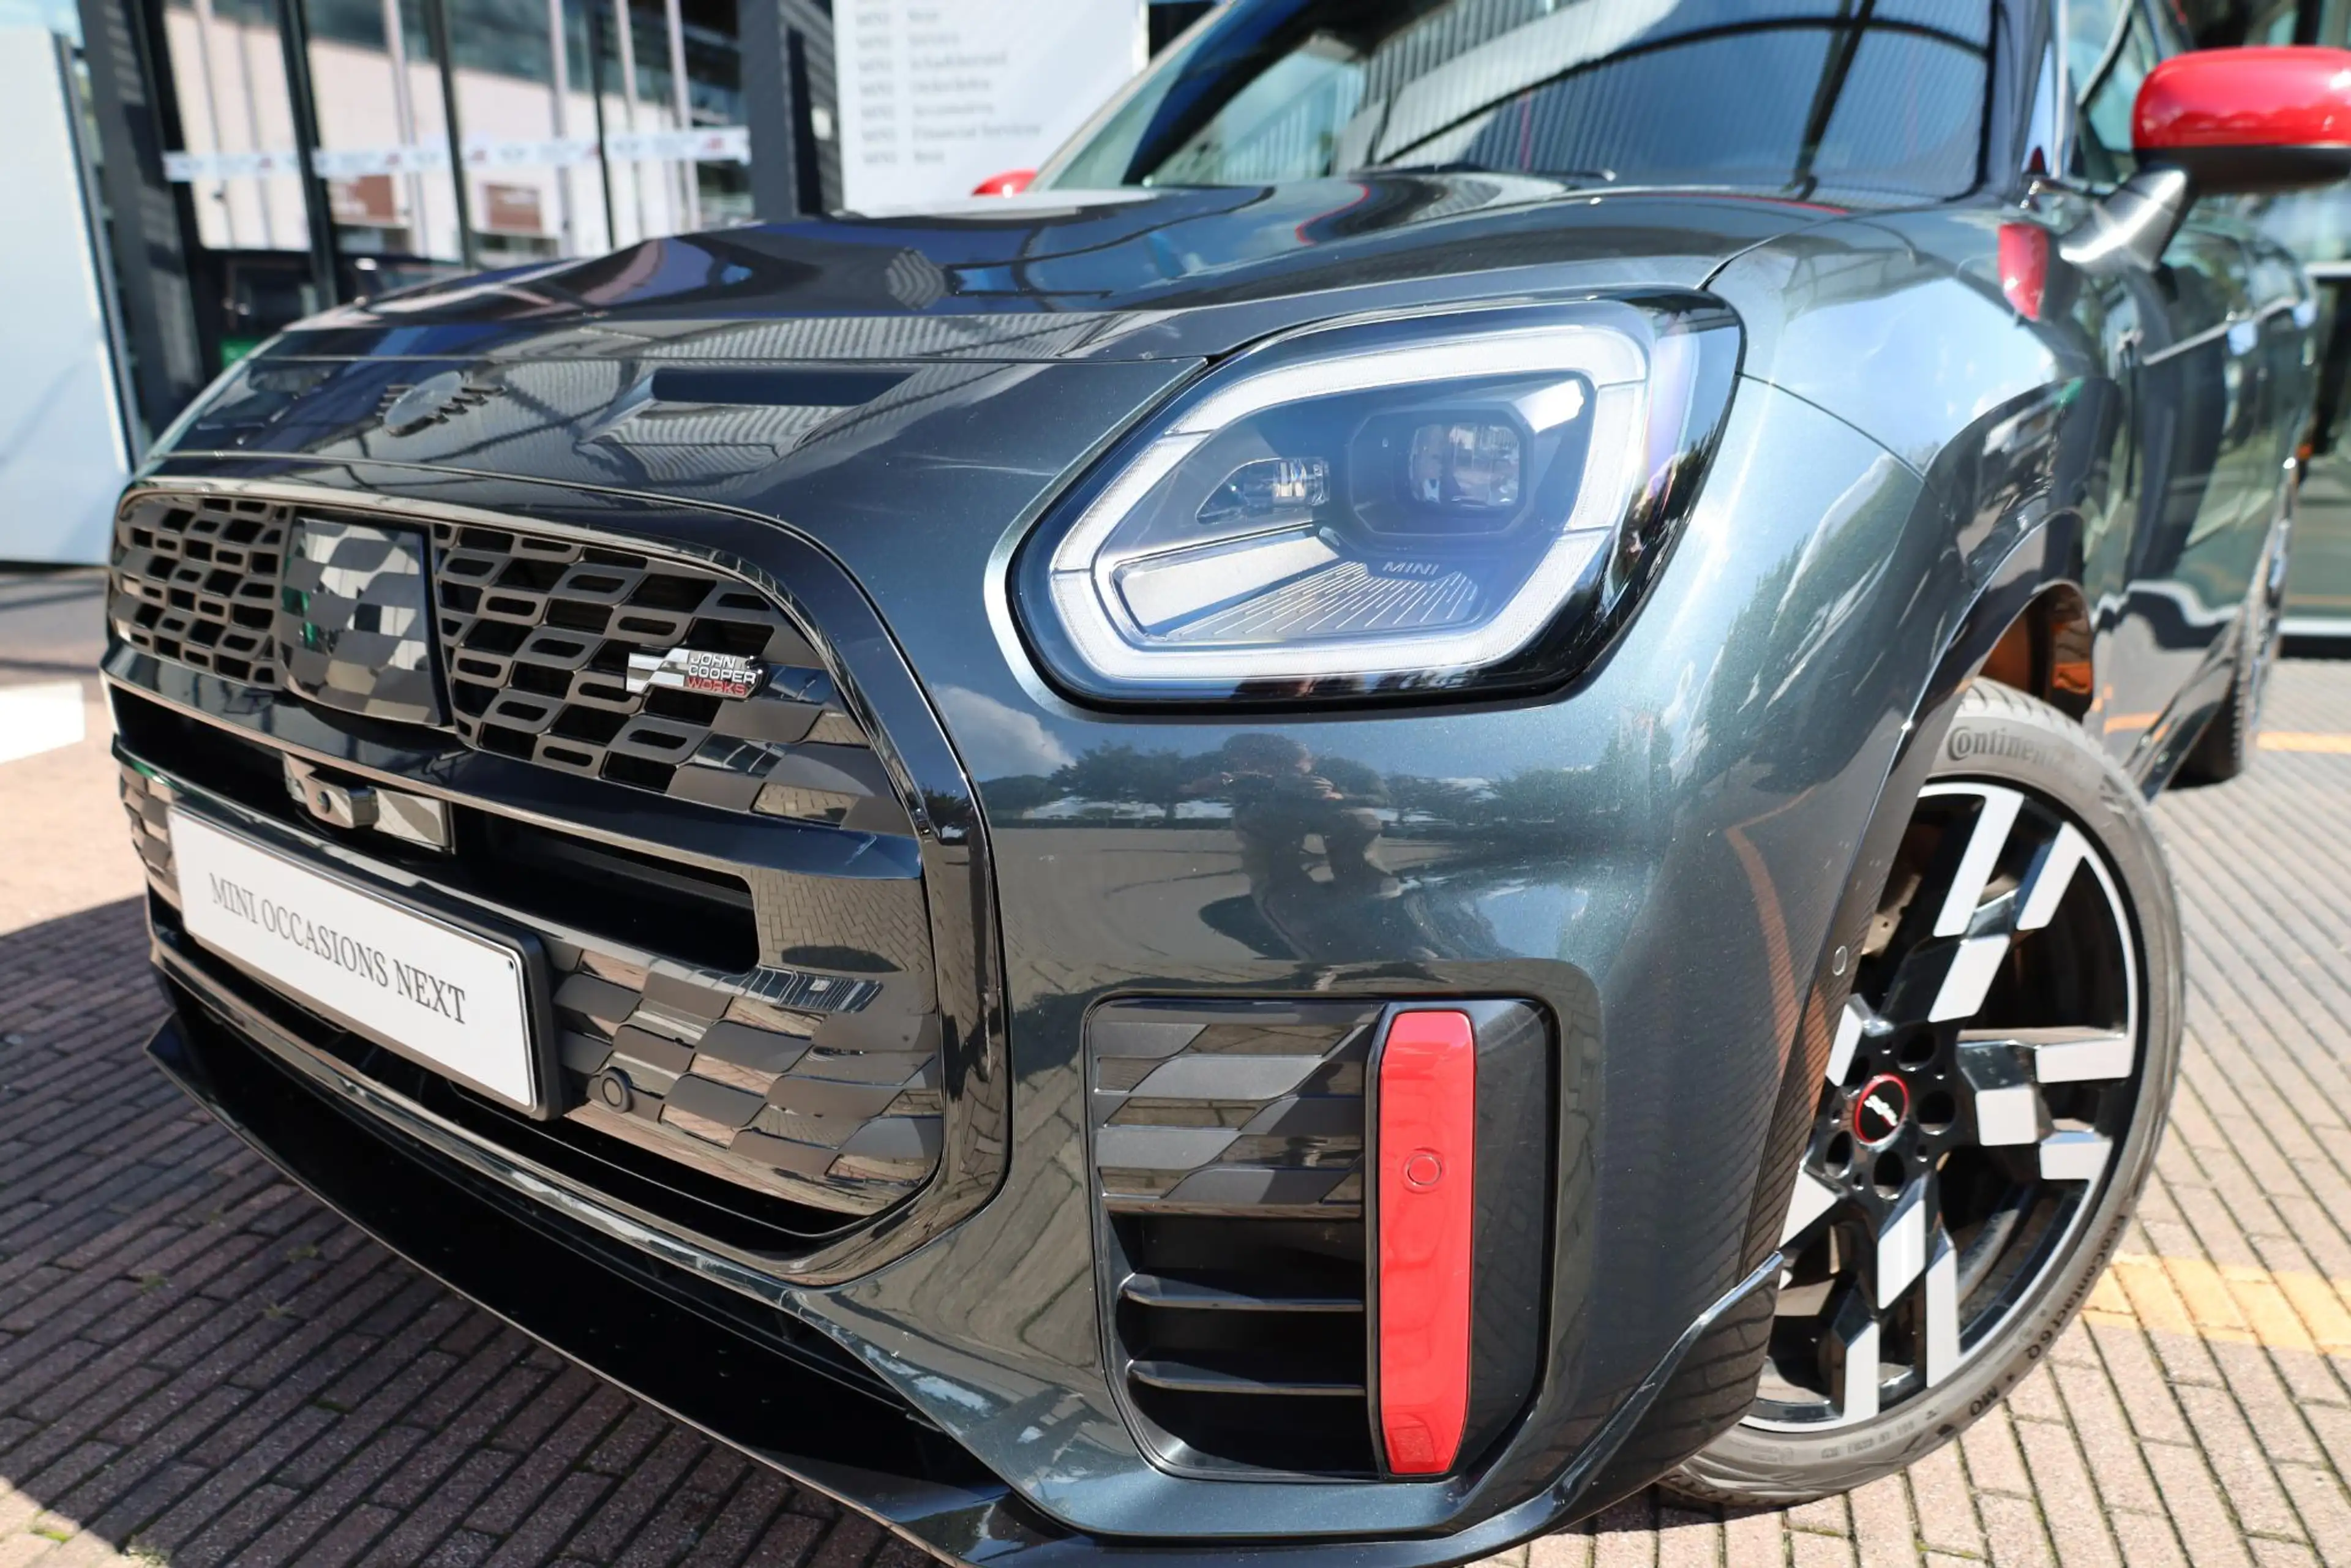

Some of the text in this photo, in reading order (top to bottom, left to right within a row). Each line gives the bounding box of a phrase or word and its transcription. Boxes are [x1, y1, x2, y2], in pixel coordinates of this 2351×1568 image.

[1382, 561, 1439, 575] MINI
[691, 653, 735, 669] JOHN
[688, 665, 756, 685] COOPER
[687, 677, 748, 696] WORKS
[209, 872, 465, 1024] MINI OCCASIONS NEXT
